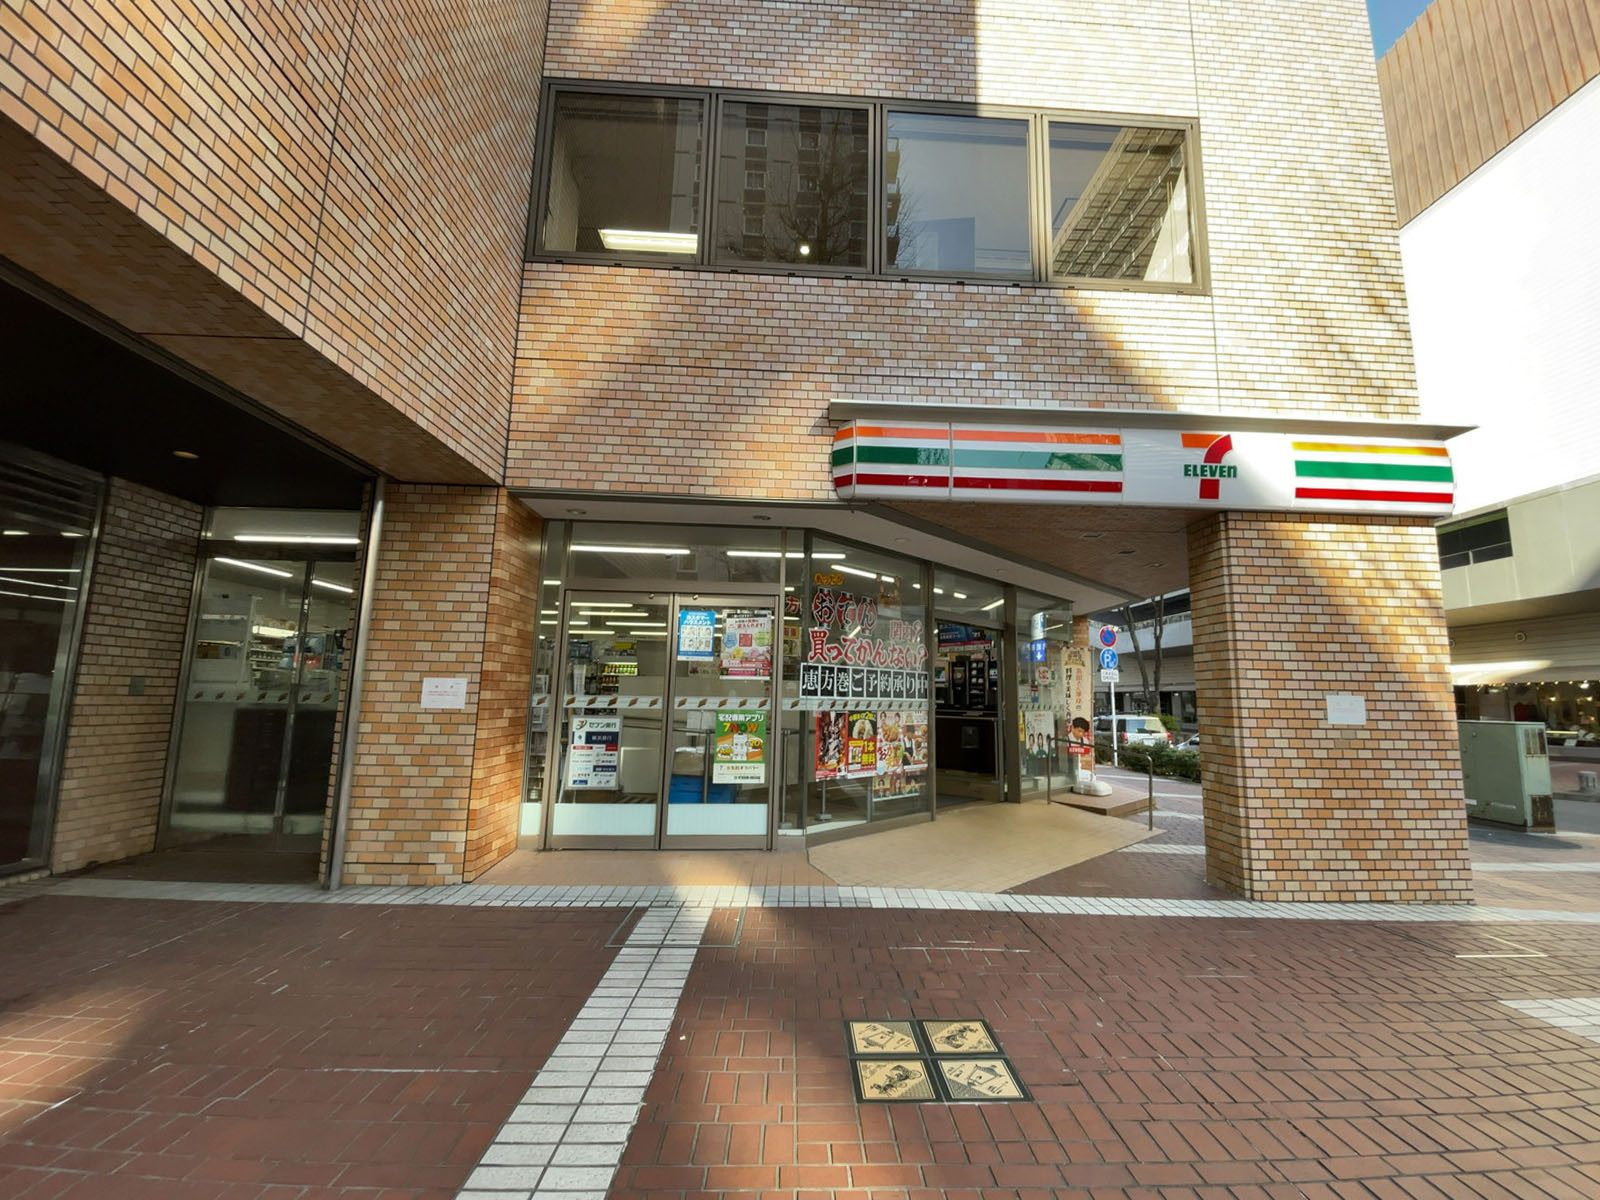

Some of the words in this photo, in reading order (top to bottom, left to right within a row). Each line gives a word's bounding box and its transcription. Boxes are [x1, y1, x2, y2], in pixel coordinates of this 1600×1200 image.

[1180, 433, 1233, 500] 7
[802, 668, 928, 694] 恵方巻ご予約承り中
